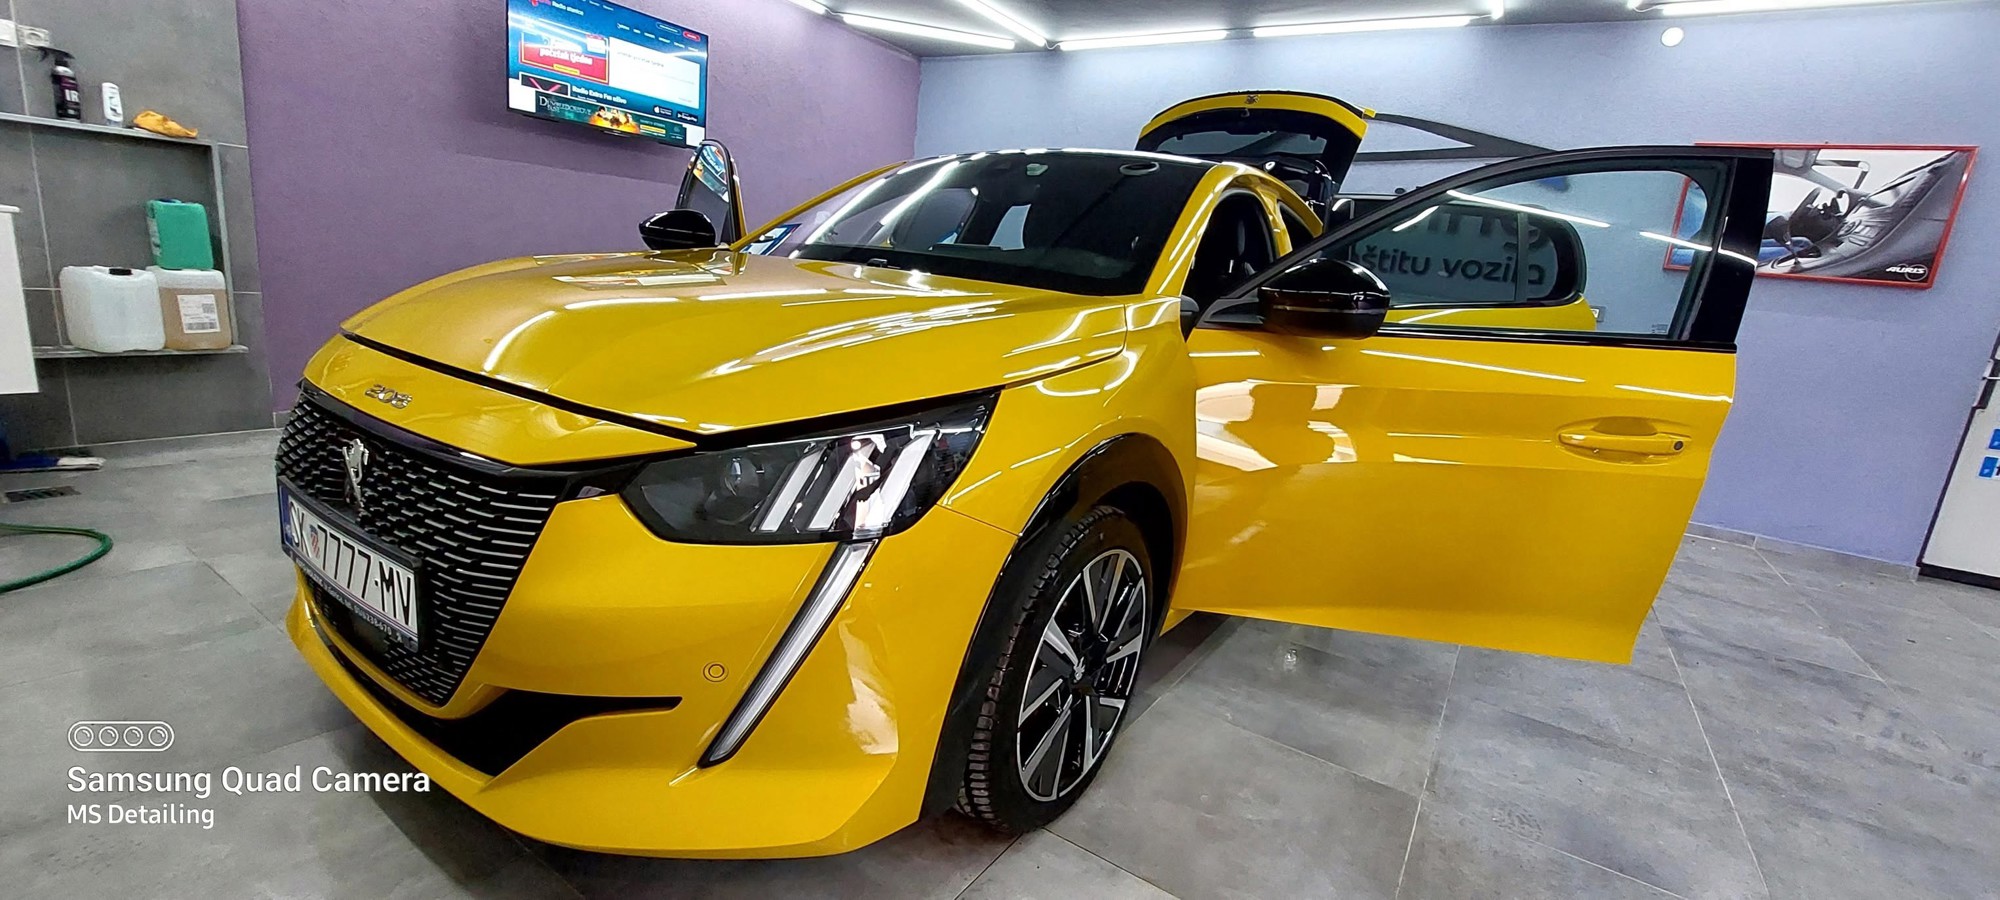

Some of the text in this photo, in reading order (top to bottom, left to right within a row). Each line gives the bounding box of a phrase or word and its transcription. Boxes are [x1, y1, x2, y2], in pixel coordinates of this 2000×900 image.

[1886, 266, 1925, 274] AURIS
[365, 383, 412, 409] 208
[288, 501, 311, 558] SK
